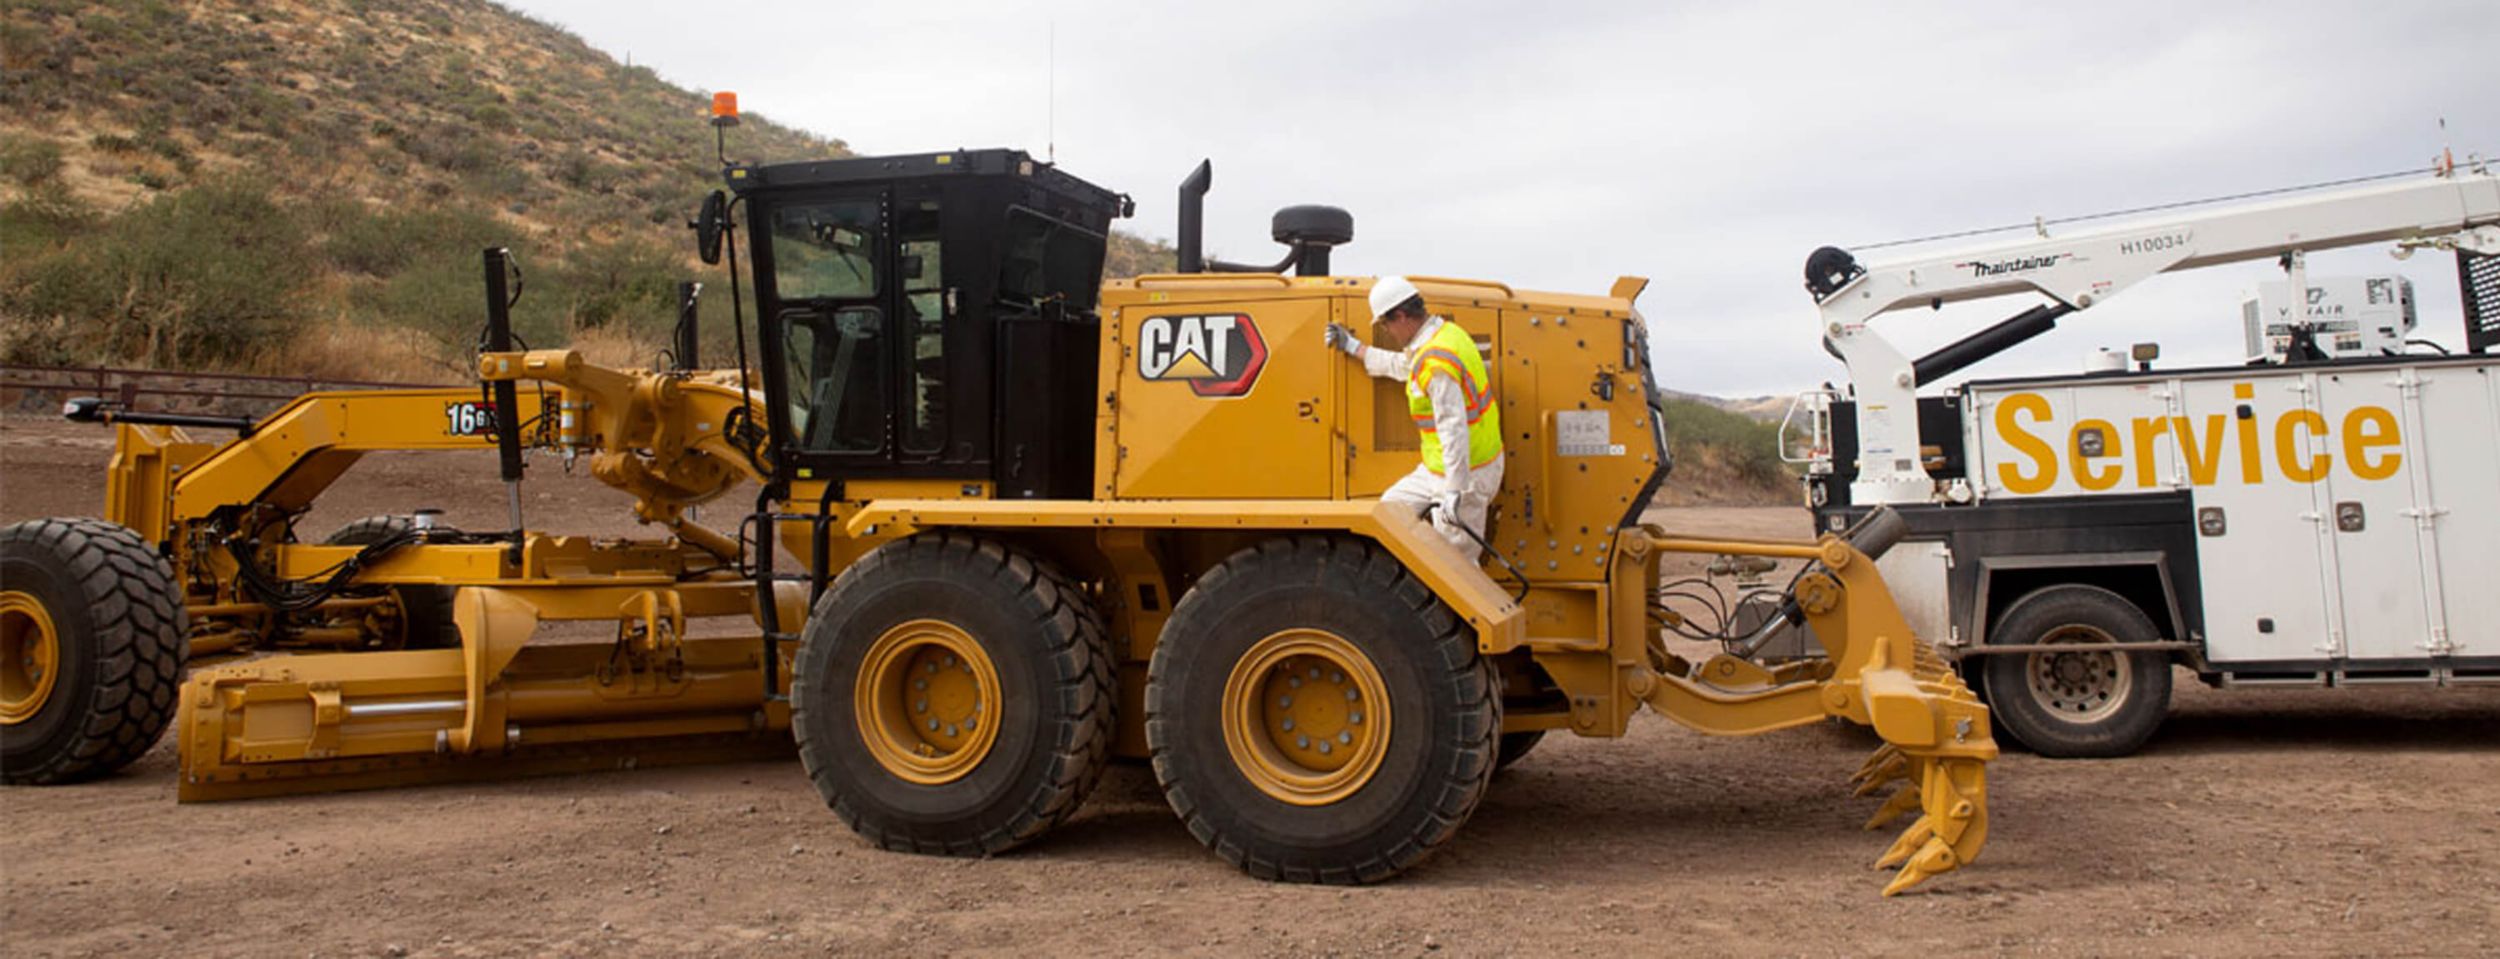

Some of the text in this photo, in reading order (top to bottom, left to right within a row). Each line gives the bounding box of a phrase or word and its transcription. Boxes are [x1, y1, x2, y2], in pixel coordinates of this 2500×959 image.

[2121, 234, 2185, 255] H10034
[1969, 254, 2060, 278] Maintainer
[2278, 304, 2344, 317] VAIR
[1140, 315, 1236, 379] CAT
[1994, 383, 2402, 494] Service
